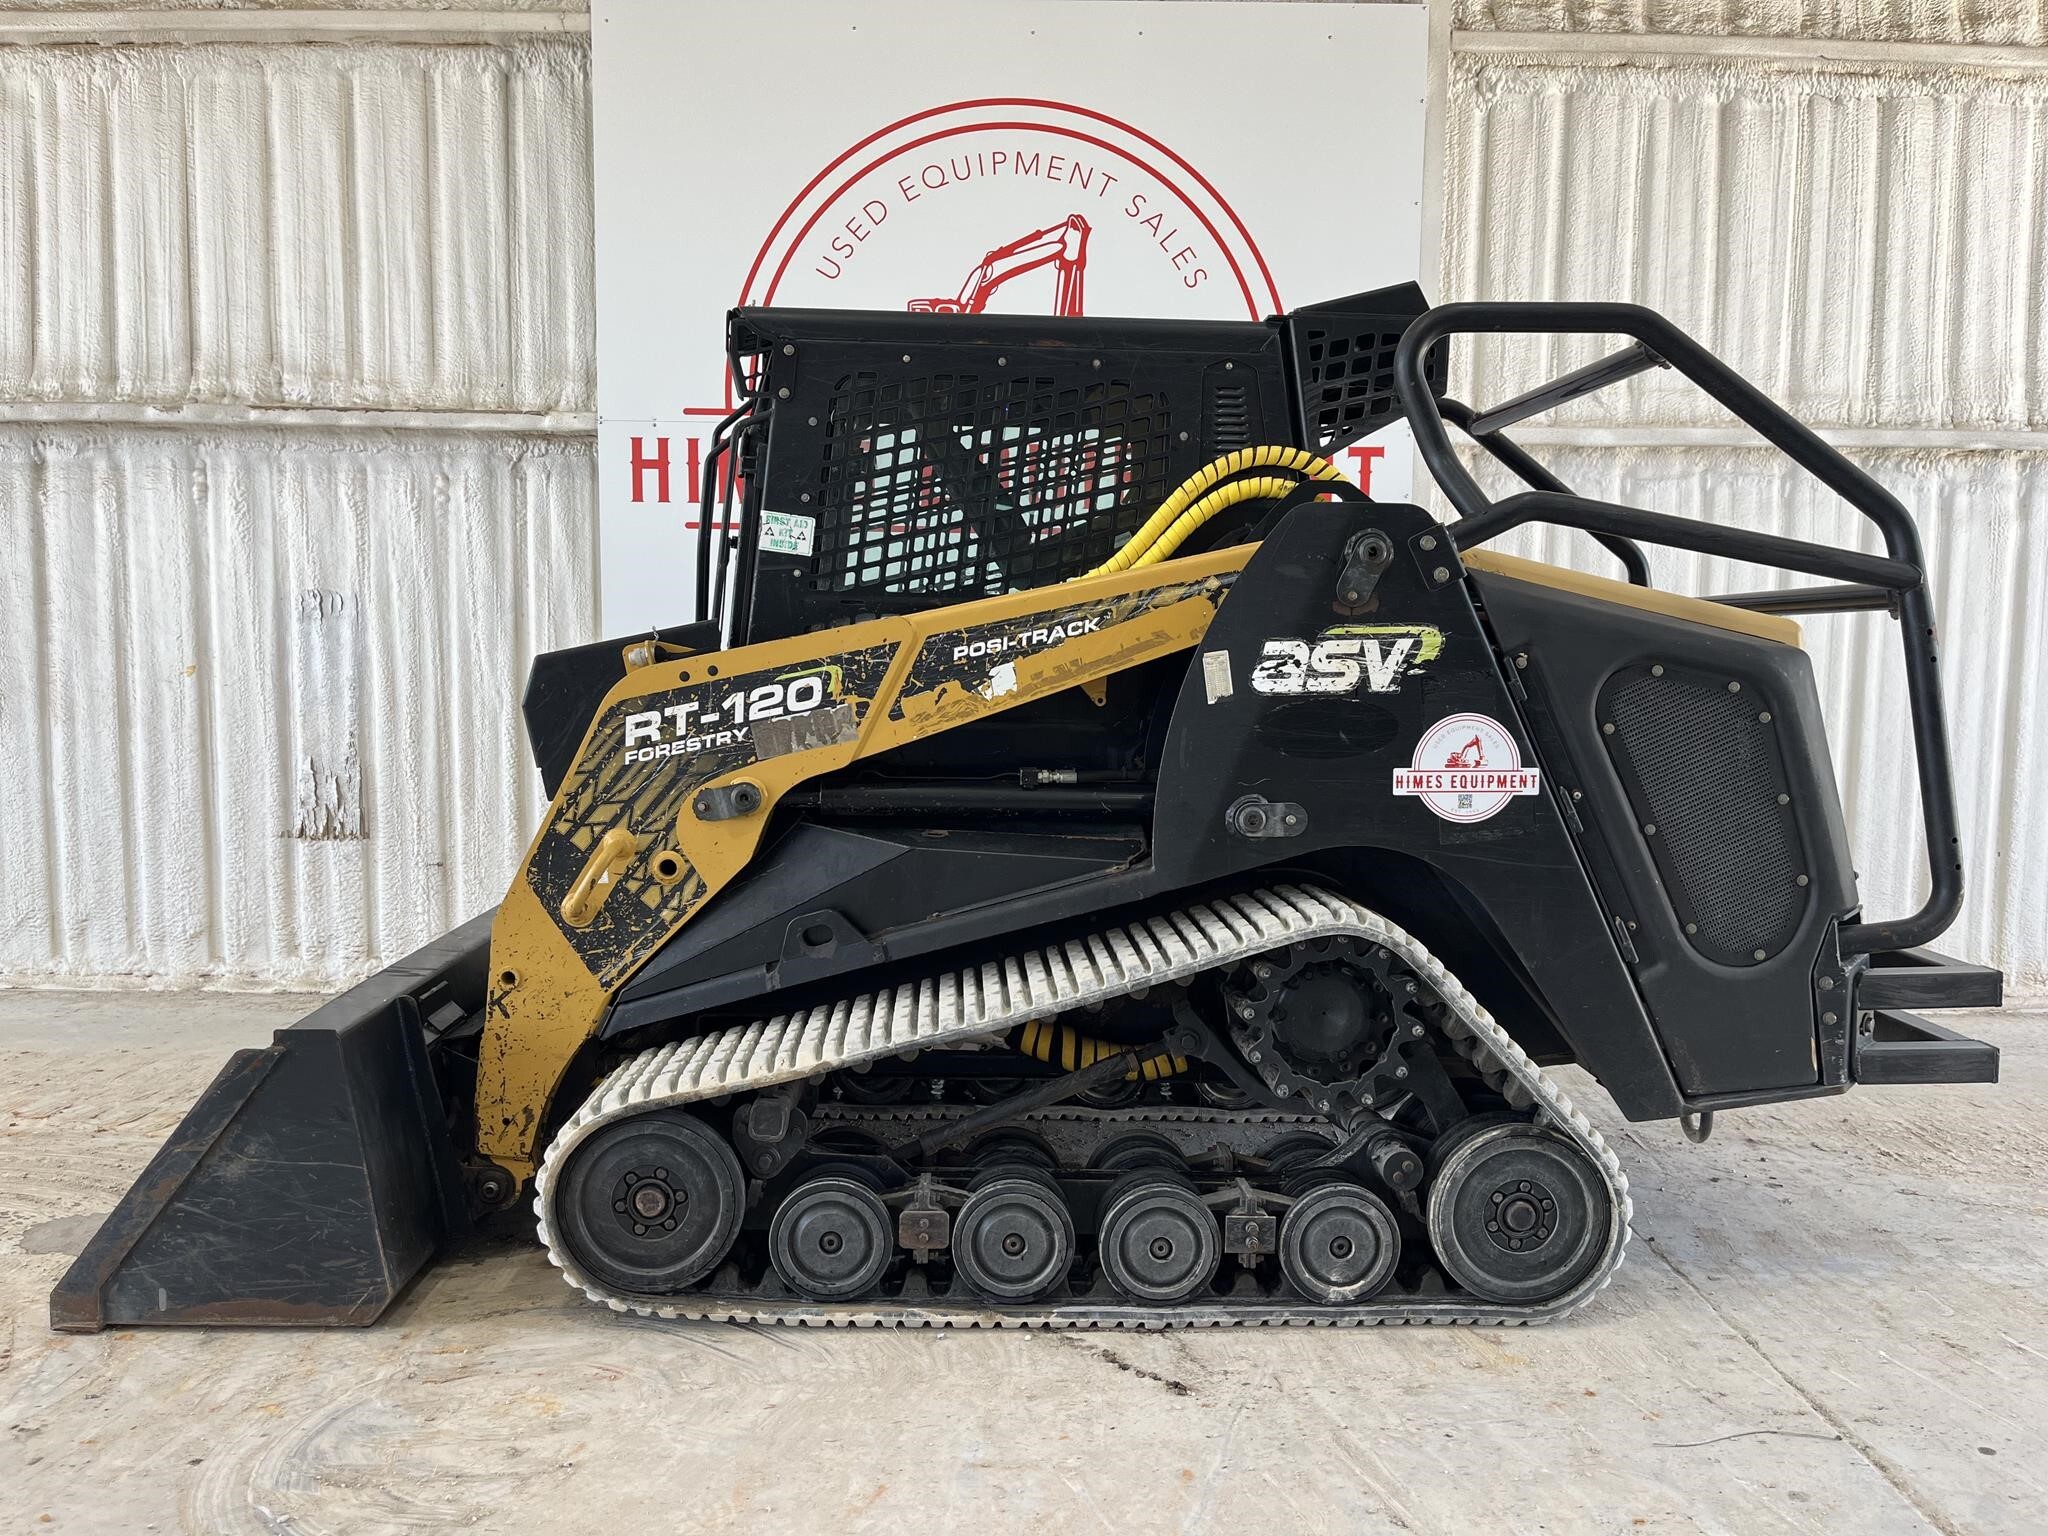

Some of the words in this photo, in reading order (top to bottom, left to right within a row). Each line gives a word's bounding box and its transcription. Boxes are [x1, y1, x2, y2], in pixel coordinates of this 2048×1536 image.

[815, 200, 888, 280] USED
[897, 150, 1119, 203] EQUIPMENT
[1124, 194, 1208, 289] SALES
[953, 616, 1101, 661] POSI-TRACK
[624, 676, 824, 748] RT-120
[624, 727, 750, 766] FORESTRY
[1395, 774, 1443, 789] HIMES
[1450, 774, 1537, 789] EQUIPMENT
